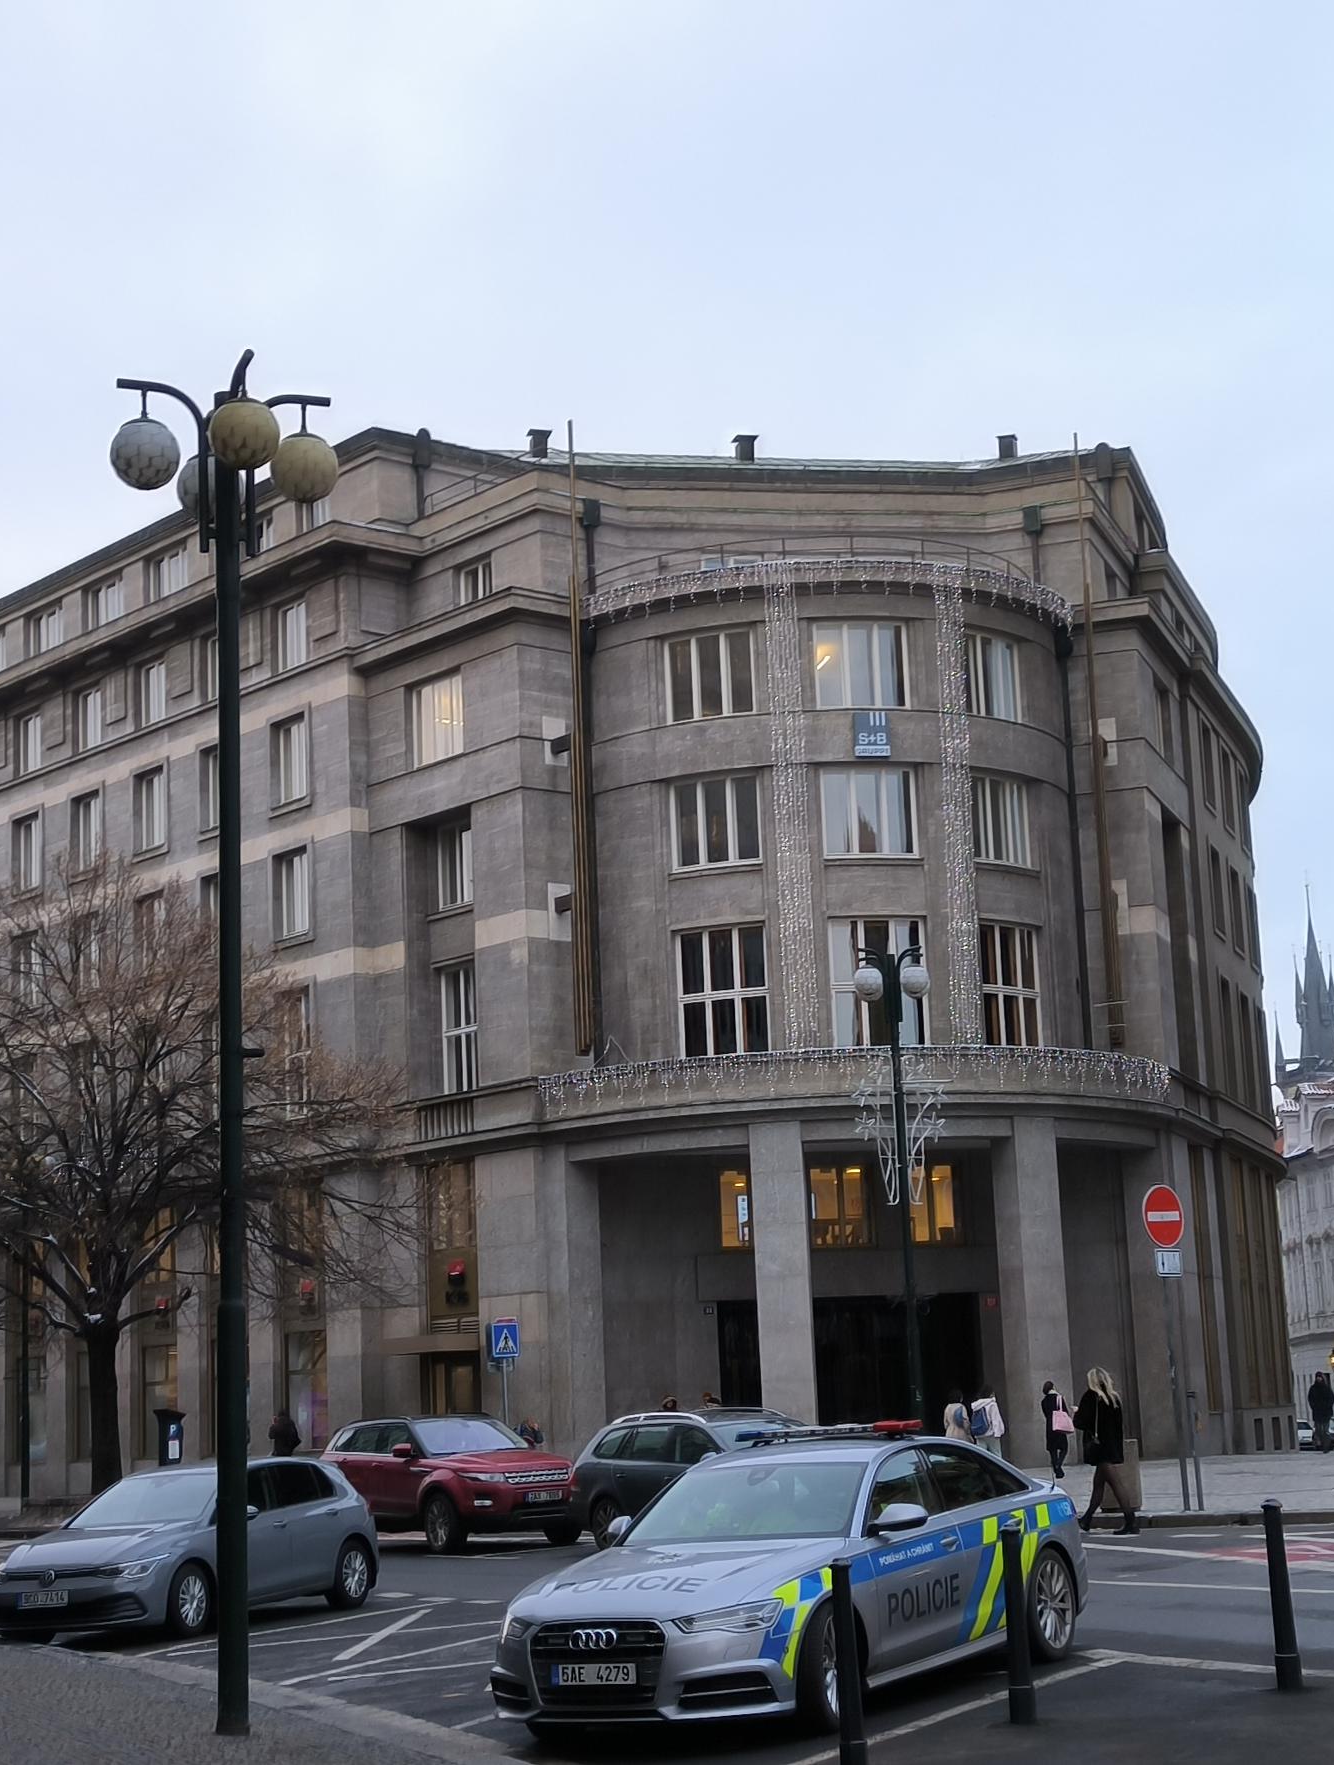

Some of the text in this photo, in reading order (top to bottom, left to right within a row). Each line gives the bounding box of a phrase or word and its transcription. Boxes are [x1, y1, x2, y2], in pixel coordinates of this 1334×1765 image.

[858, 732, 887, 745] S+B
[170, 1424, 178, 1436] P
[546, 1575, 708, 1598] POLICIE
[887, 1573, 960, 1628] POLICIE
[596, 1665, 630, 1683] 4279
